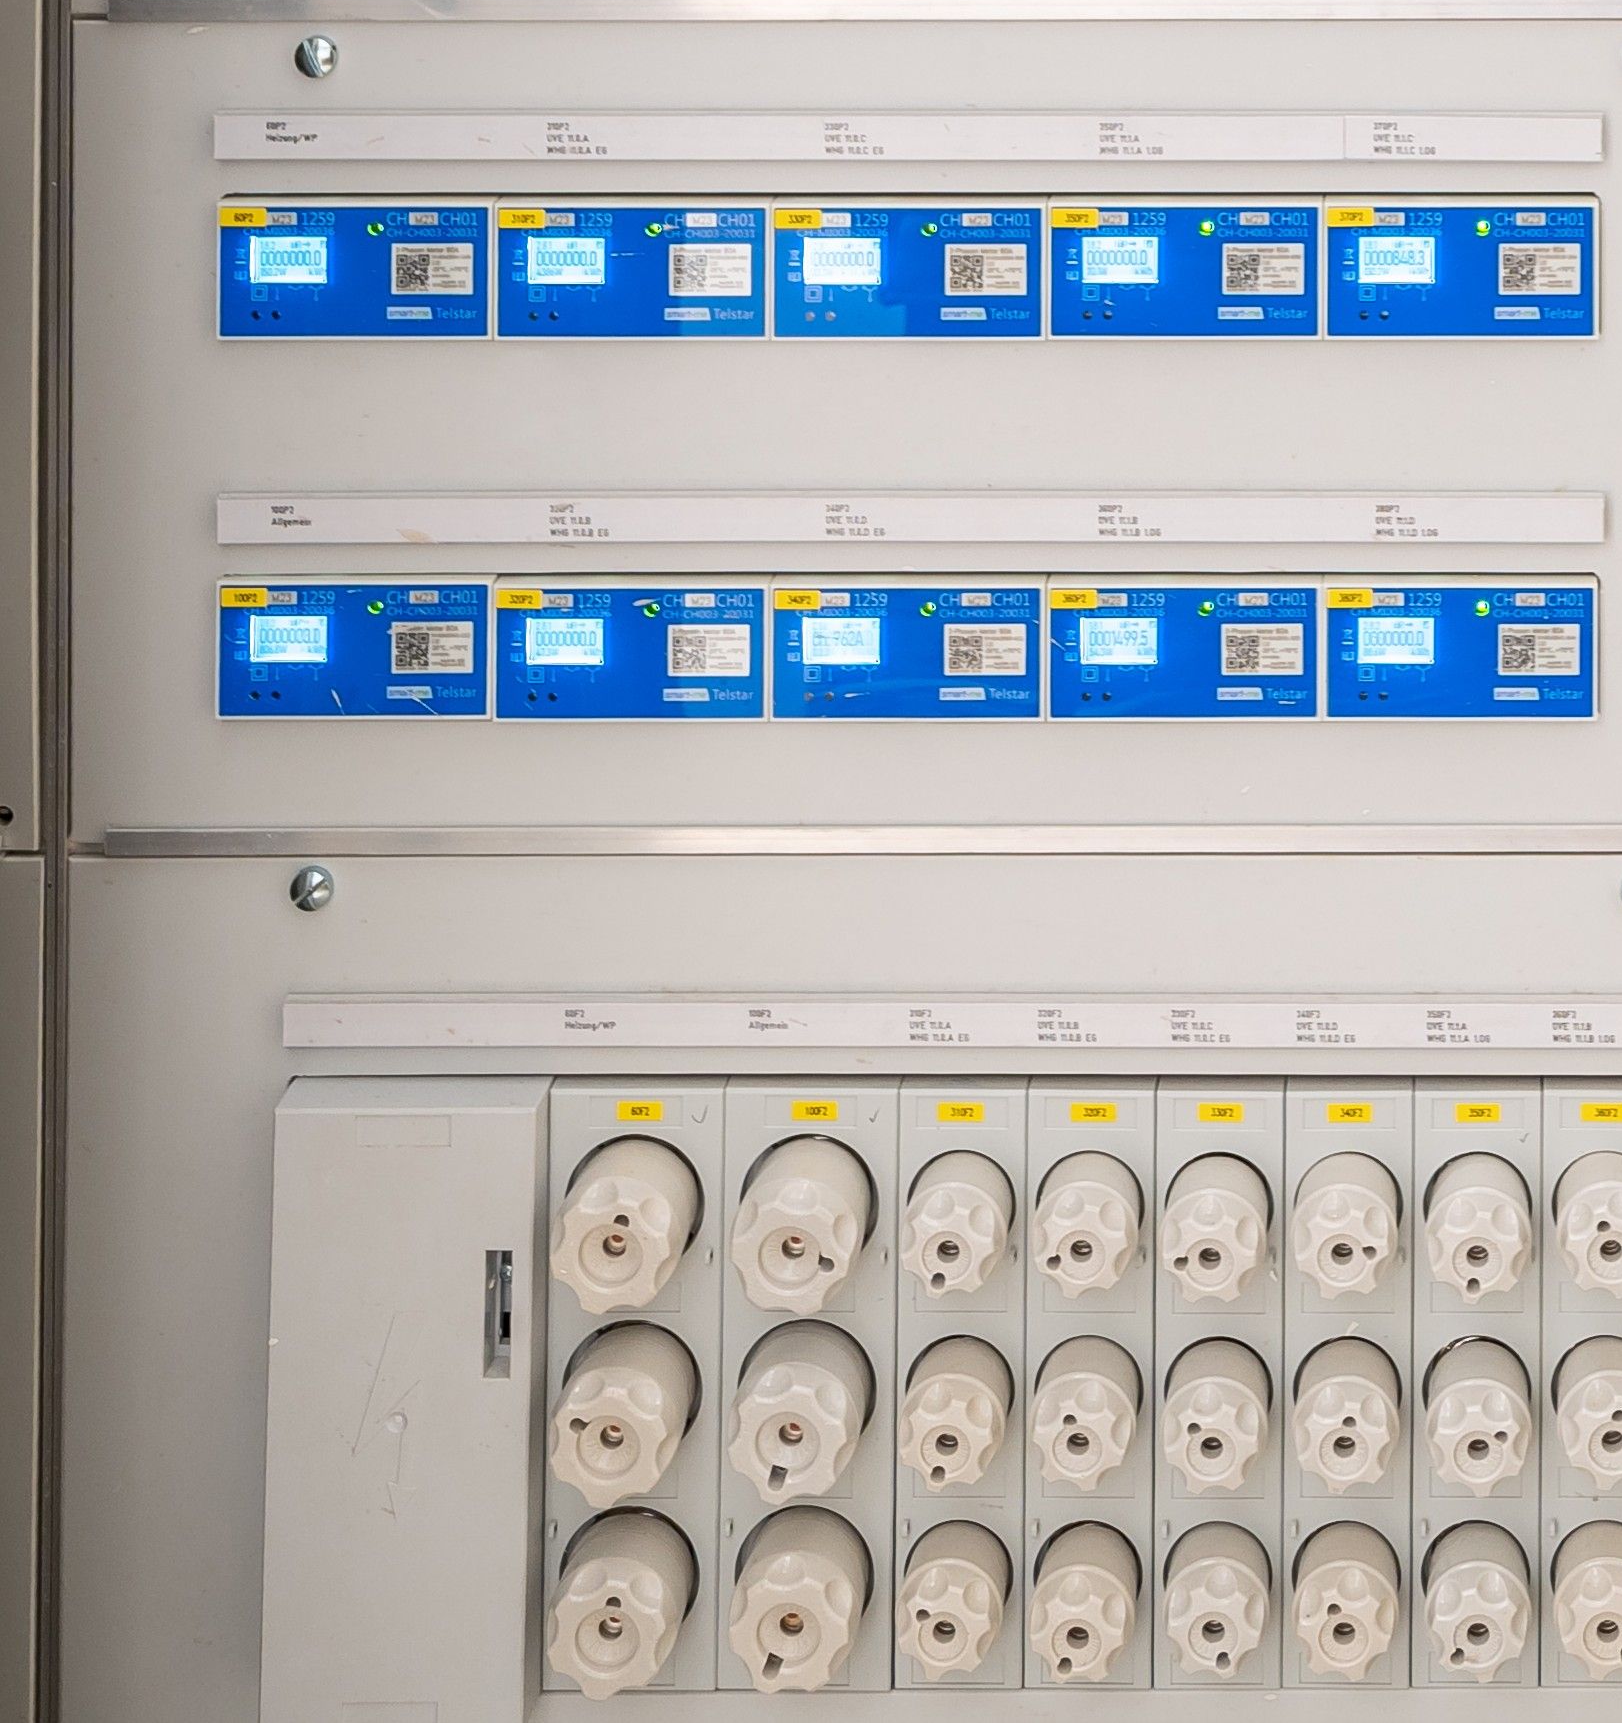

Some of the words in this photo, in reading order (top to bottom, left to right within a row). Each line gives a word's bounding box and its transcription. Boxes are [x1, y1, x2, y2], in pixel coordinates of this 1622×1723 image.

[301, 211, 336, 226] 1259
[439, 211, 479, 226] CH01
[579, 212, 614, 227] 1259
[717, 212, 757, 227] CH01
[854, 212, 889, 227] 1259
[992, 212, 1032, 227] CH01
[1132, 211, 1167, 226] 1259
[1270, 211, 1310, 226] CH01
[1408, 211, 1443, 226] 1259
[1546, 211, 1586, 226] CH01
[436, 306, 478, 320] Telstar
[301, 590, 336, 605] 1259
[439, 589, 479, 604] CH01
[577, 593, 612, 608] 1259
[715, 592, 755, 607] CH01
[854, 592, 889, 607] 1259
[991, 591, 1031, 606] CH01
[1131, 592, 1166, 607] 1259
[1269, 591, 1309, 606] CH01
[1408, 592, 1443, 607] 1259
[1546, 592, 1586, 607] CH01
[1266, 686, 1308, 700] Telstar
